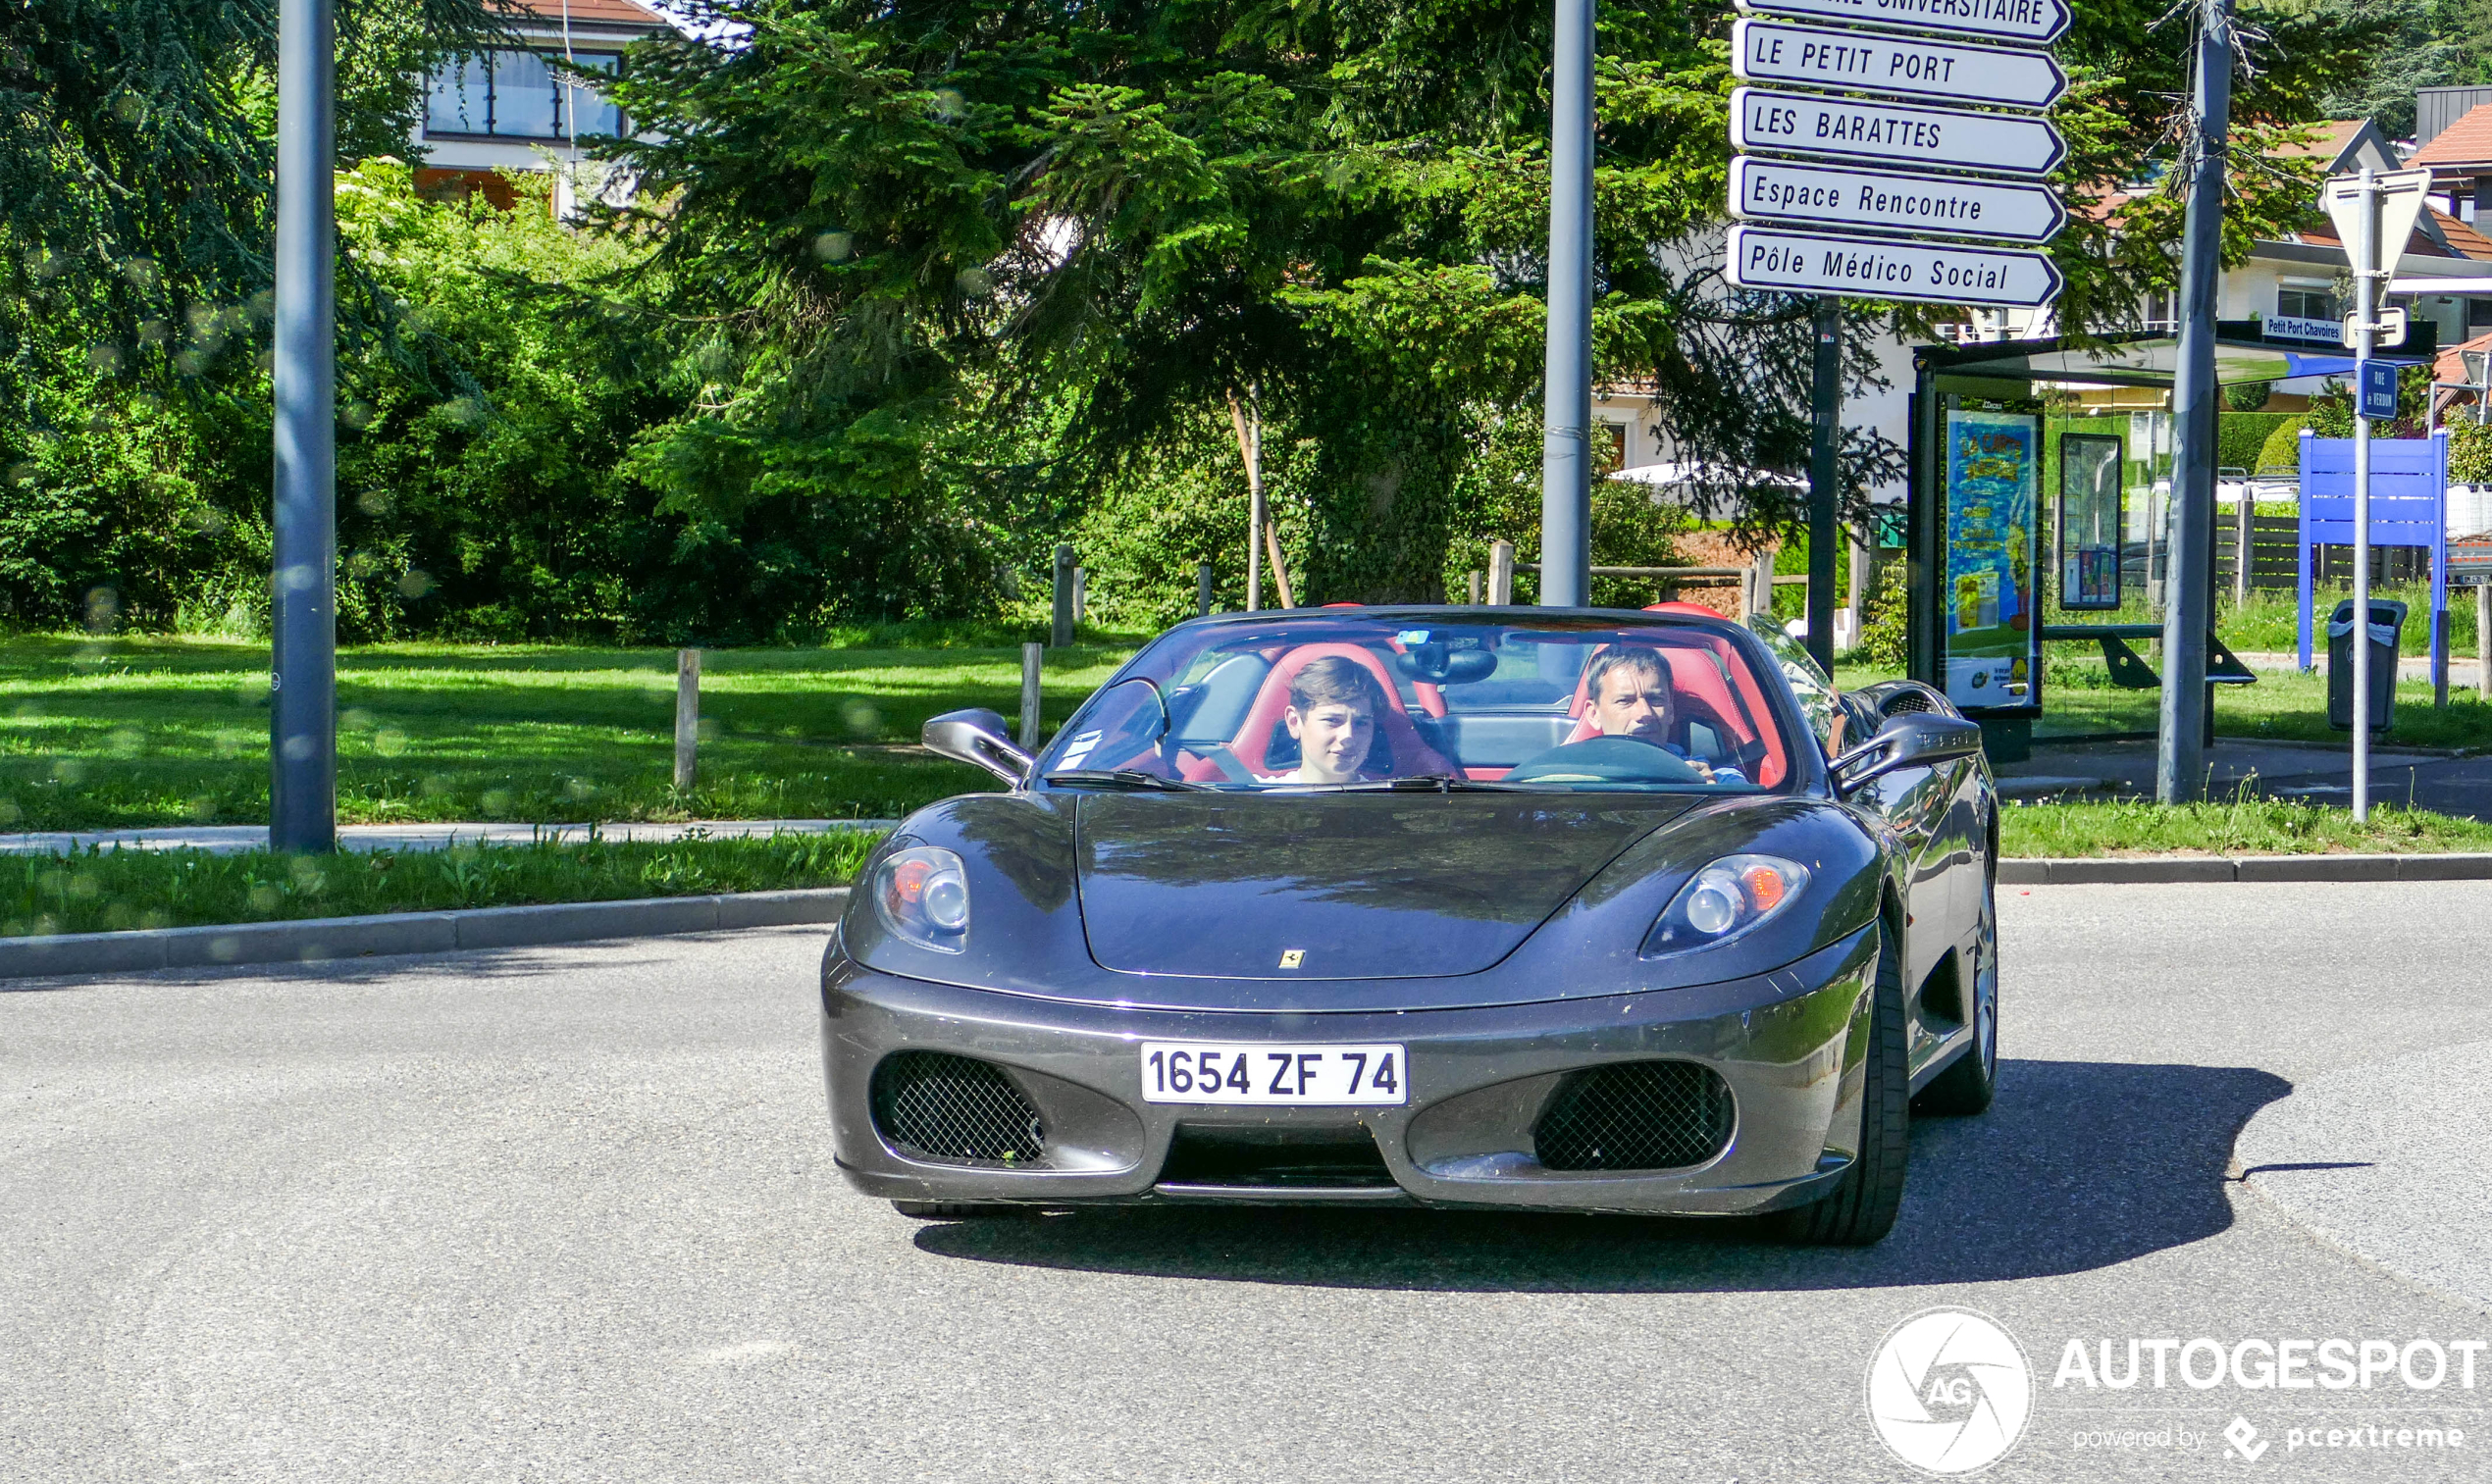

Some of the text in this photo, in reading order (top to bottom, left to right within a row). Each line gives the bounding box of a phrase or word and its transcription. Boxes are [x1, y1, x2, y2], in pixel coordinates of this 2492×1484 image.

[1756, 37, 1954, 81] LE PETIT PORT
[1754, 107, 1941, 148] LES BARATTES
[1754, 177, 1981, 219] Espace Rencontre
[1750, 245, 2006, 289] Pôle Médico Social
[2268, 319, 2339, 338] Petit Port Chavoires
[2374, 371, 2385, 384] RUE
[2373, 392, 2392, 407] VERDUN
[1149, 1050, 1397, 1096] 1654 ZF 74
